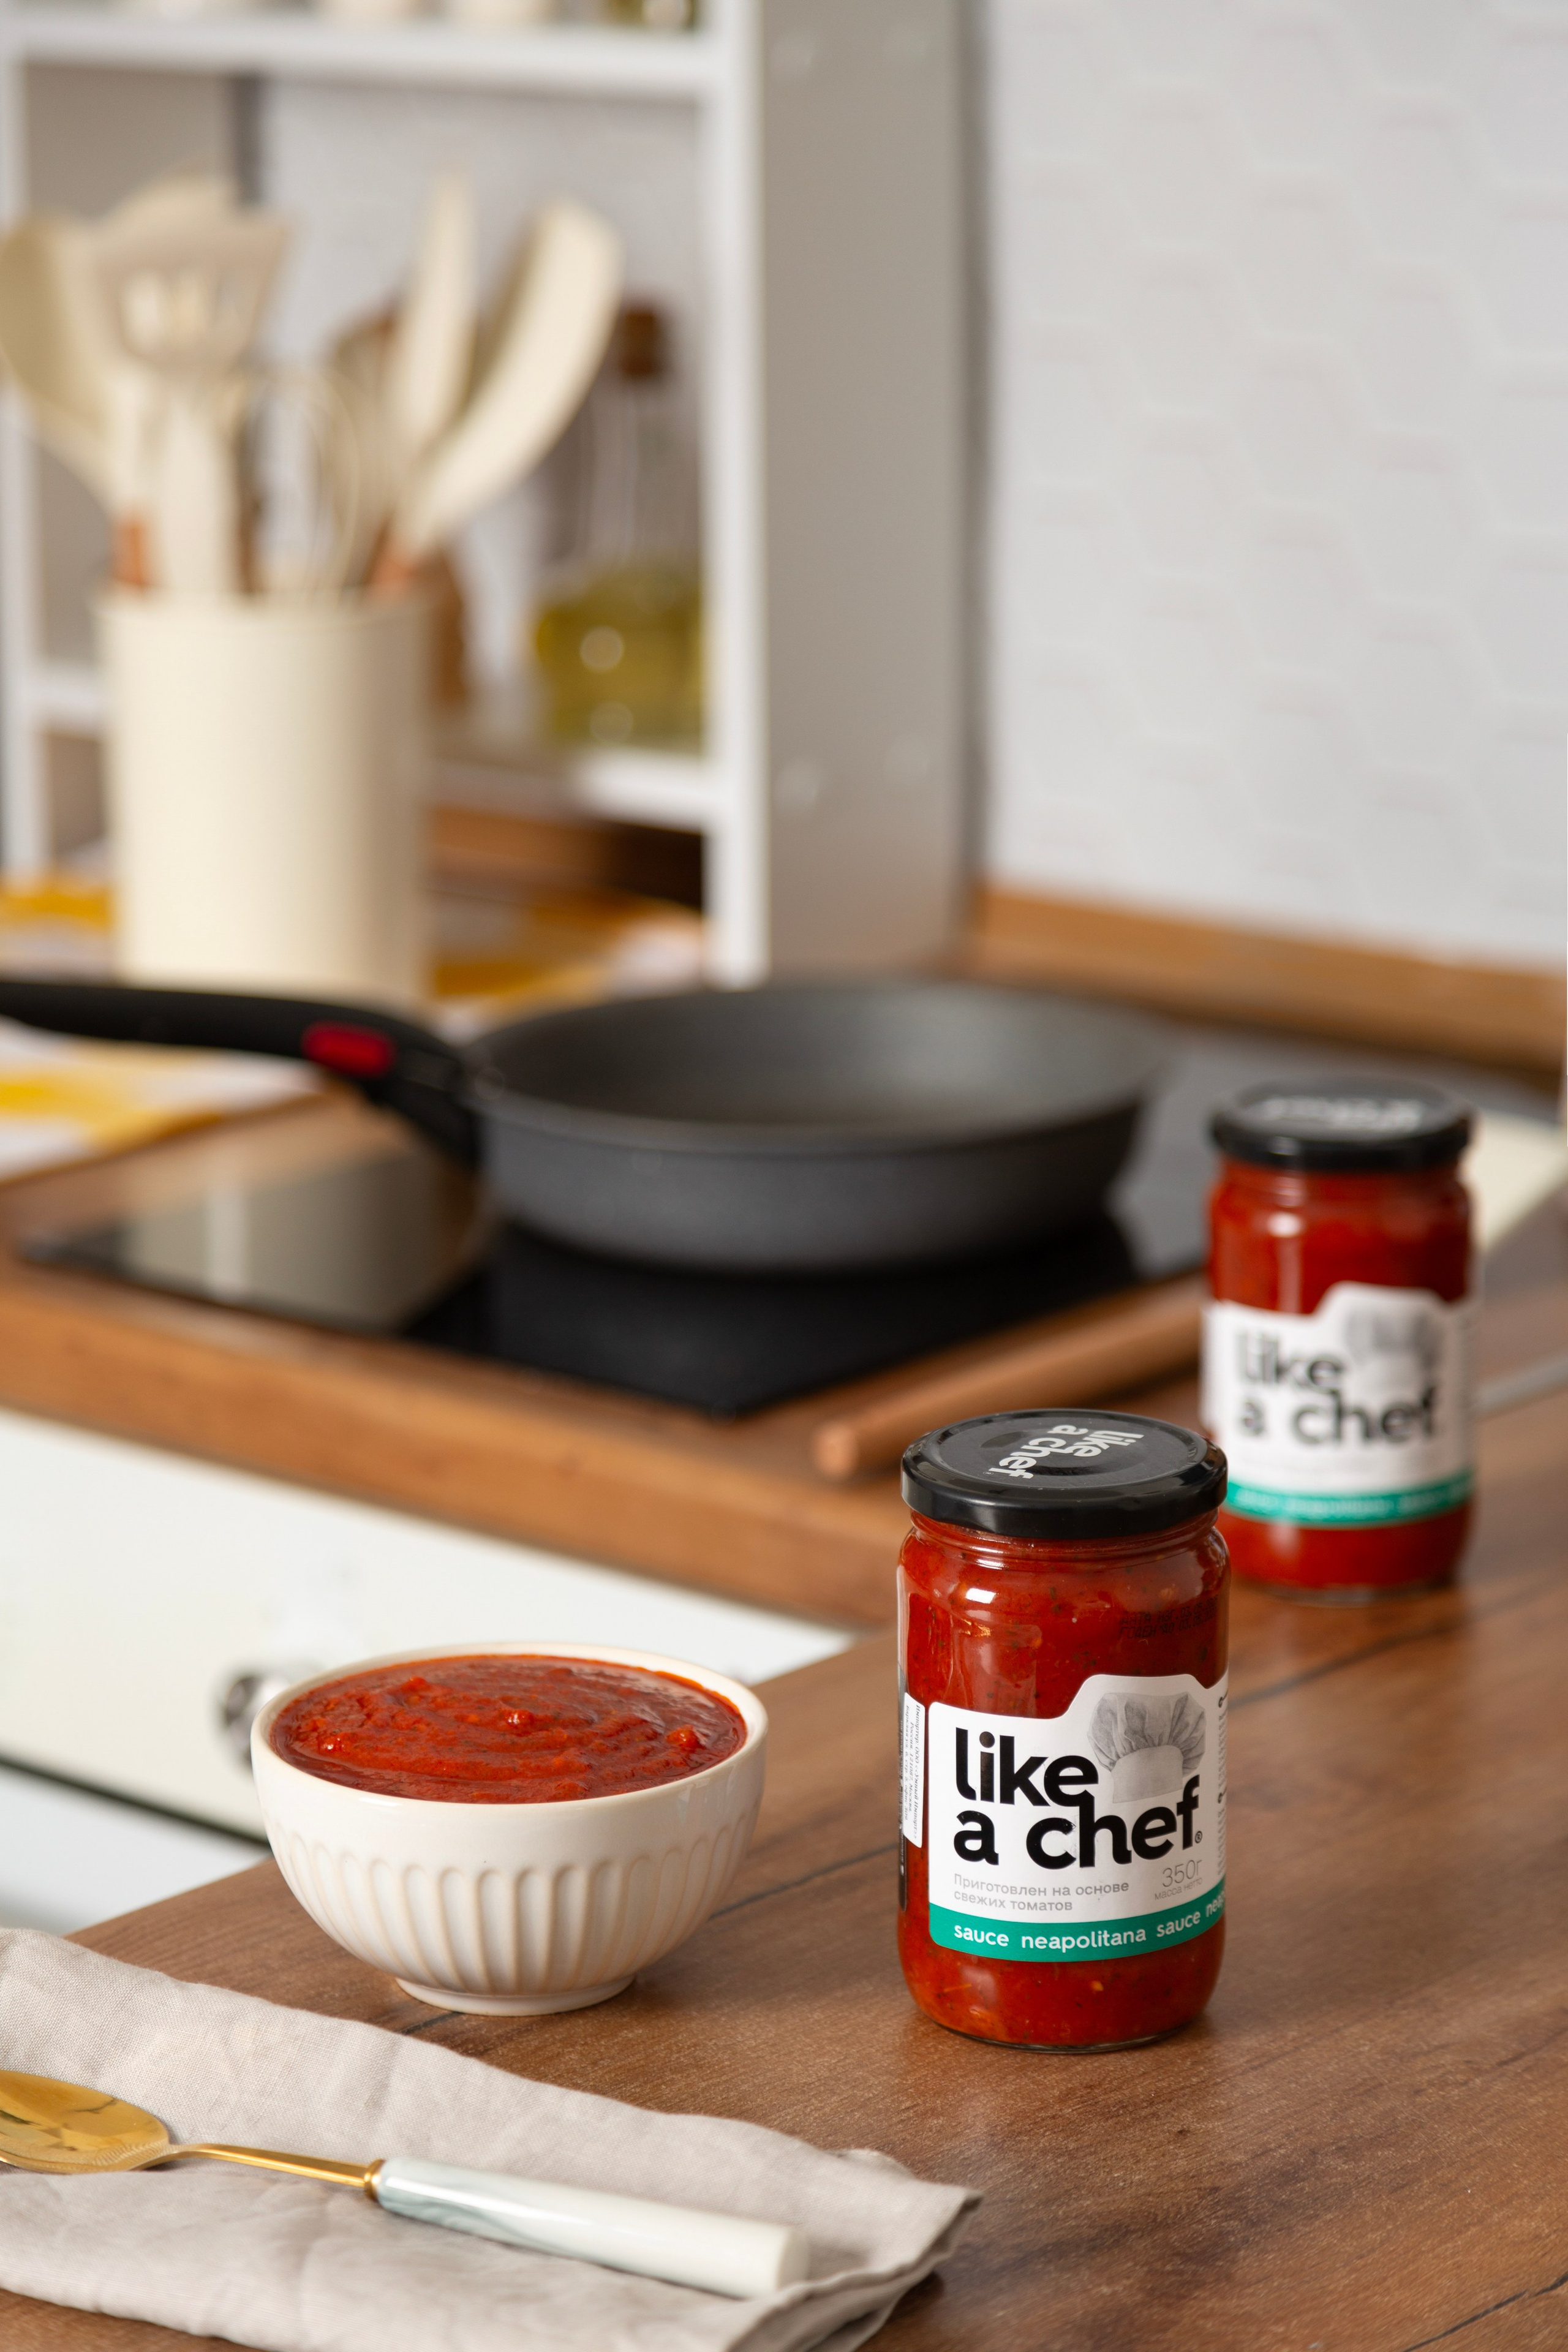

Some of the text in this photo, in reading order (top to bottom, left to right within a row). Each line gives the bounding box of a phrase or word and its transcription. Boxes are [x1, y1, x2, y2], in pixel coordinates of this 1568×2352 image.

[1237, 1329, 1346, 1393] like
[1242, 1385, 1437, 1444] a chef
[989, 1424, 1088, 1479] a chef
[1072, 1430, 1145, 1457] like
[956, 1727, 1099, 1807] like
[953, 1809, 1000, 1866] a
[1025, 1774, 1200, 1871] chef
[954, 1873, 1129, 1897] Приготовлен на основе
[1154, 1886, 1182, 1901] масса
[1162, 1860, 1203, 1888] 350г
[954, 1889, 1073, 1912] свежих томатов
[954, 1924, 1009, 1947] sauce
[1021, 1928, 1147, 1953] neapolitana
[1156, 1911, 1201, 1938] sauce
